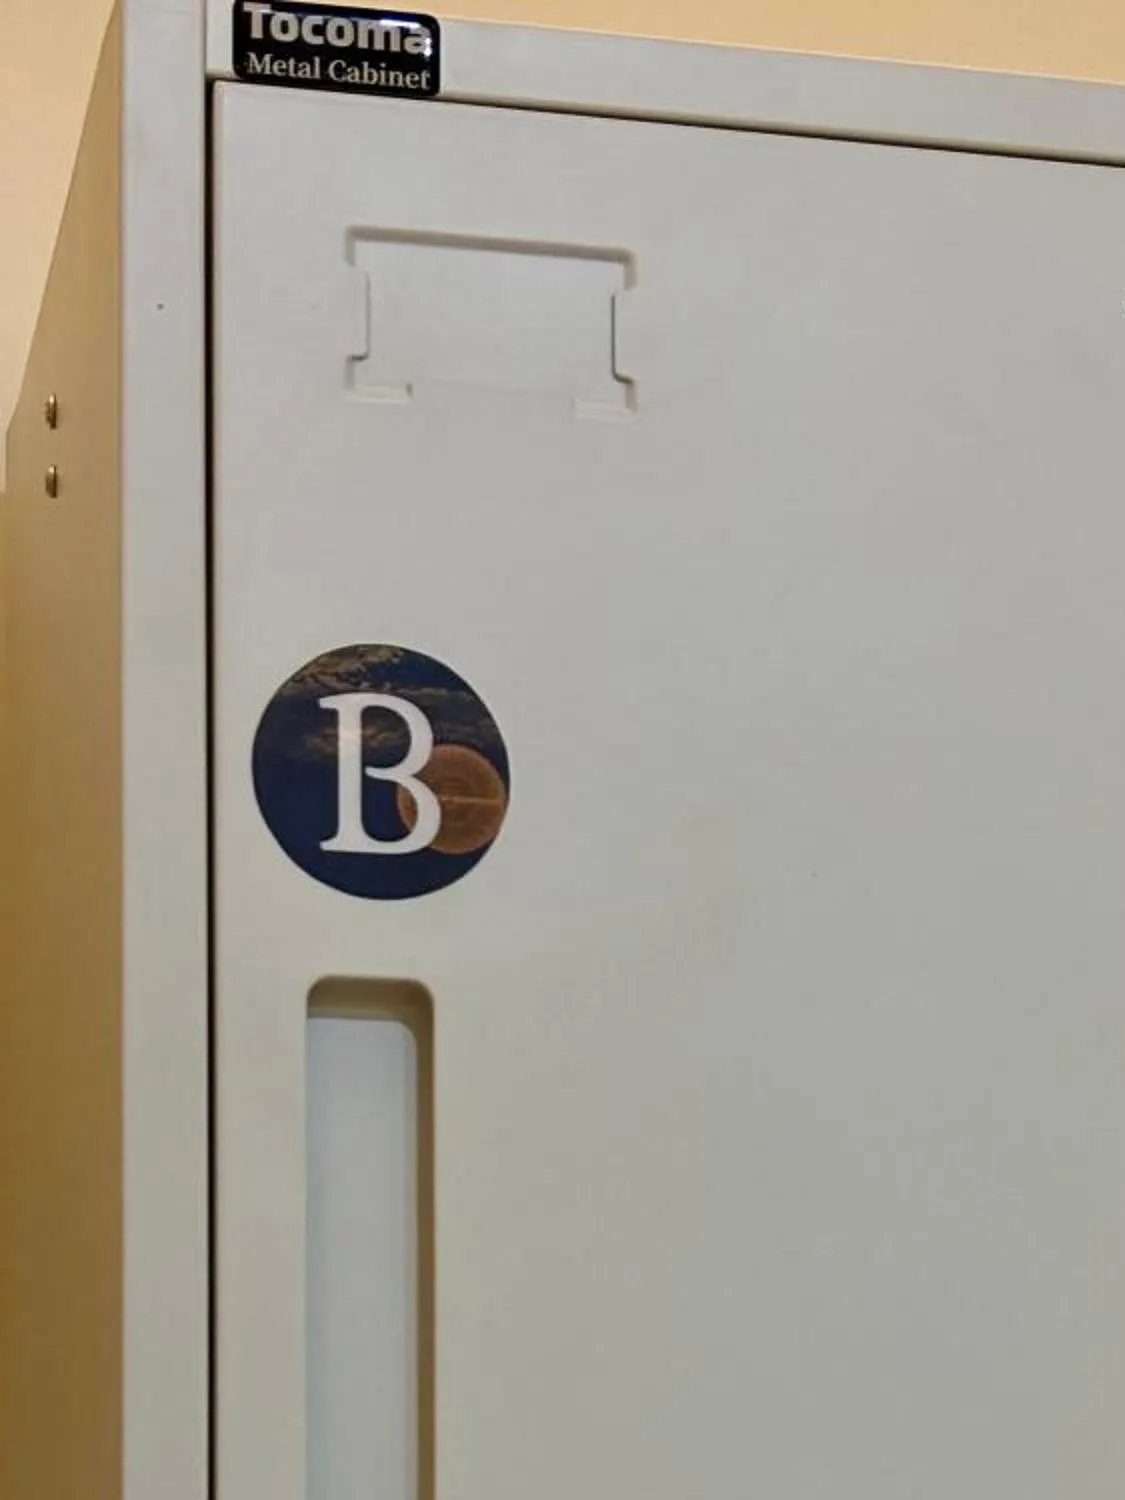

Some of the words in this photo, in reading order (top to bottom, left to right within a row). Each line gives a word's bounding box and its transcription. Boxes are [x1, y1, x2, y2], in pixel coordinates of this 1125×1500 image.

[243, 2, 432, 56] Tocoma
[247, 52, 320, 79] Metal
[328, 60, 430, 90] Cabinet
[318, 692, 441, 855] B
